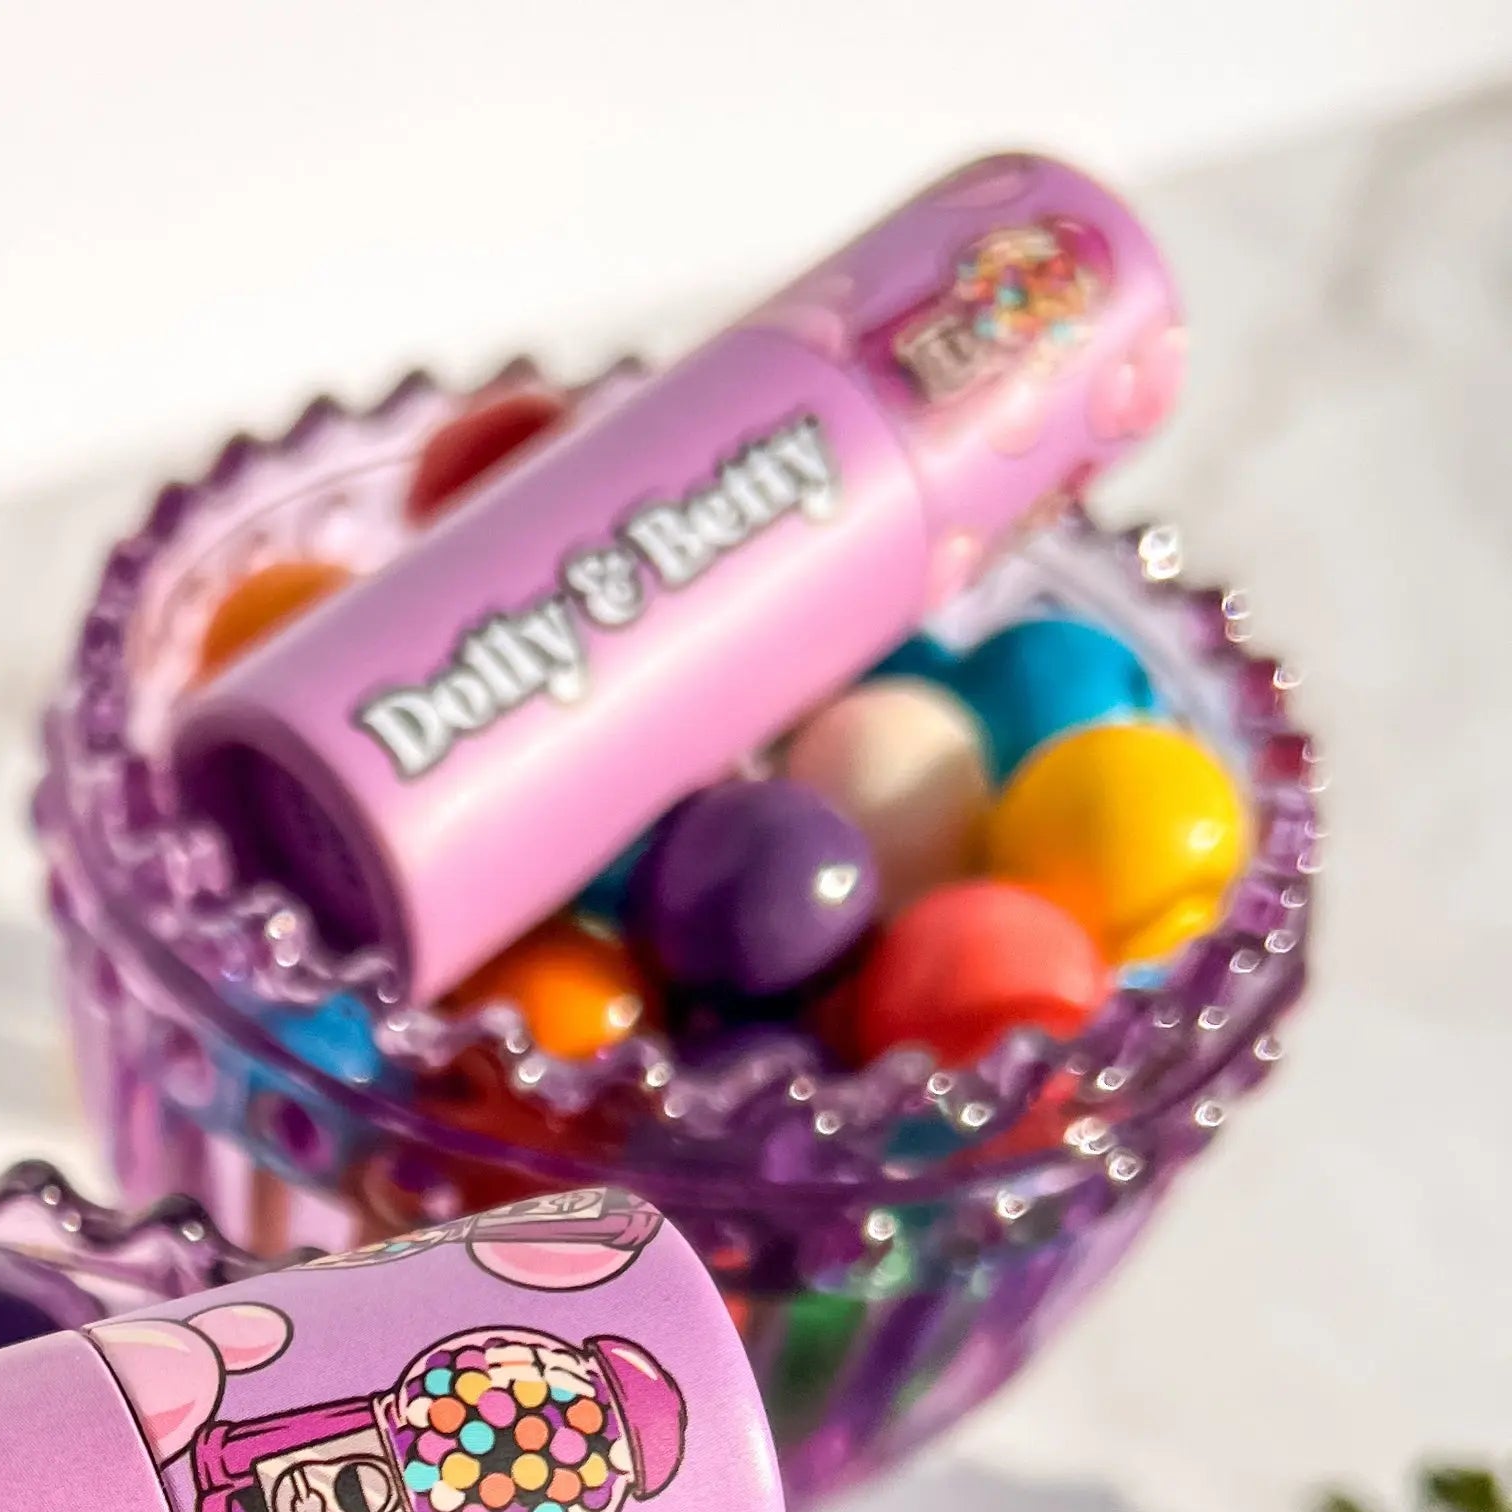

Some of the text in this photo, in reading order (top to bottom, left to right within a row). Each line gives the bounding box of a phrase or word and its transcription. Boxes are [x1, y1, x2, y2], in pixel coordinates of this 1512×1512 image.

[356, 416, 835, 778] Dolly & Betty
